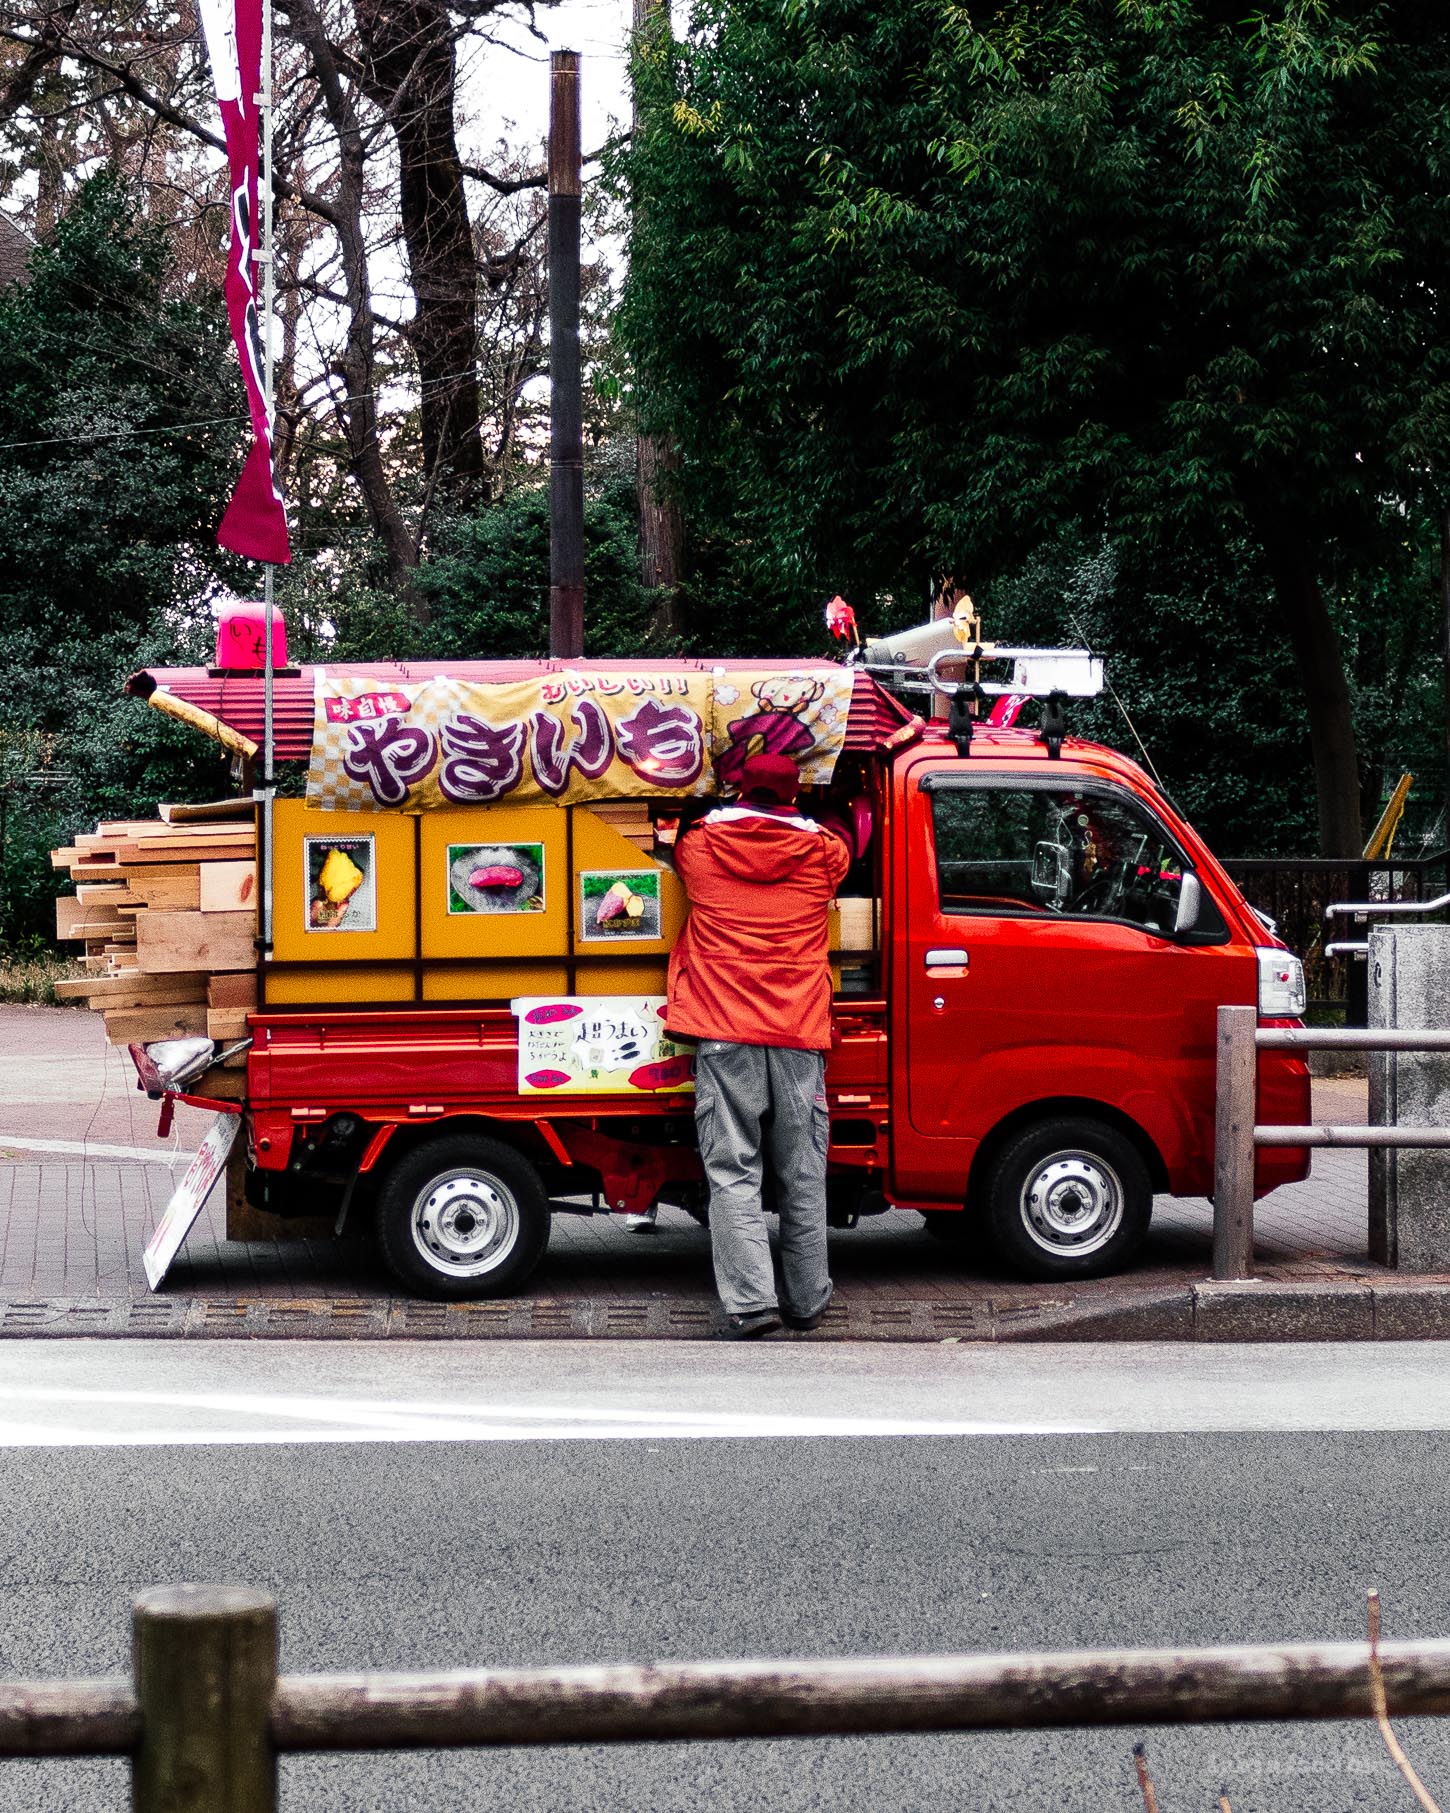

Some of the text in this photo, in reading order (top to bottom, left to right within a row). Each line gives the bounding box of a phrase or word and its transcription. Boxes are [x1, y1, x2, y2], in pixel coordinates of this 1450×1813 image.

[331, 695, 402, 720] 味自慢
[343, 700, 702, 807] やきいも
[575, 1020, 649, 1044] 超うまい
